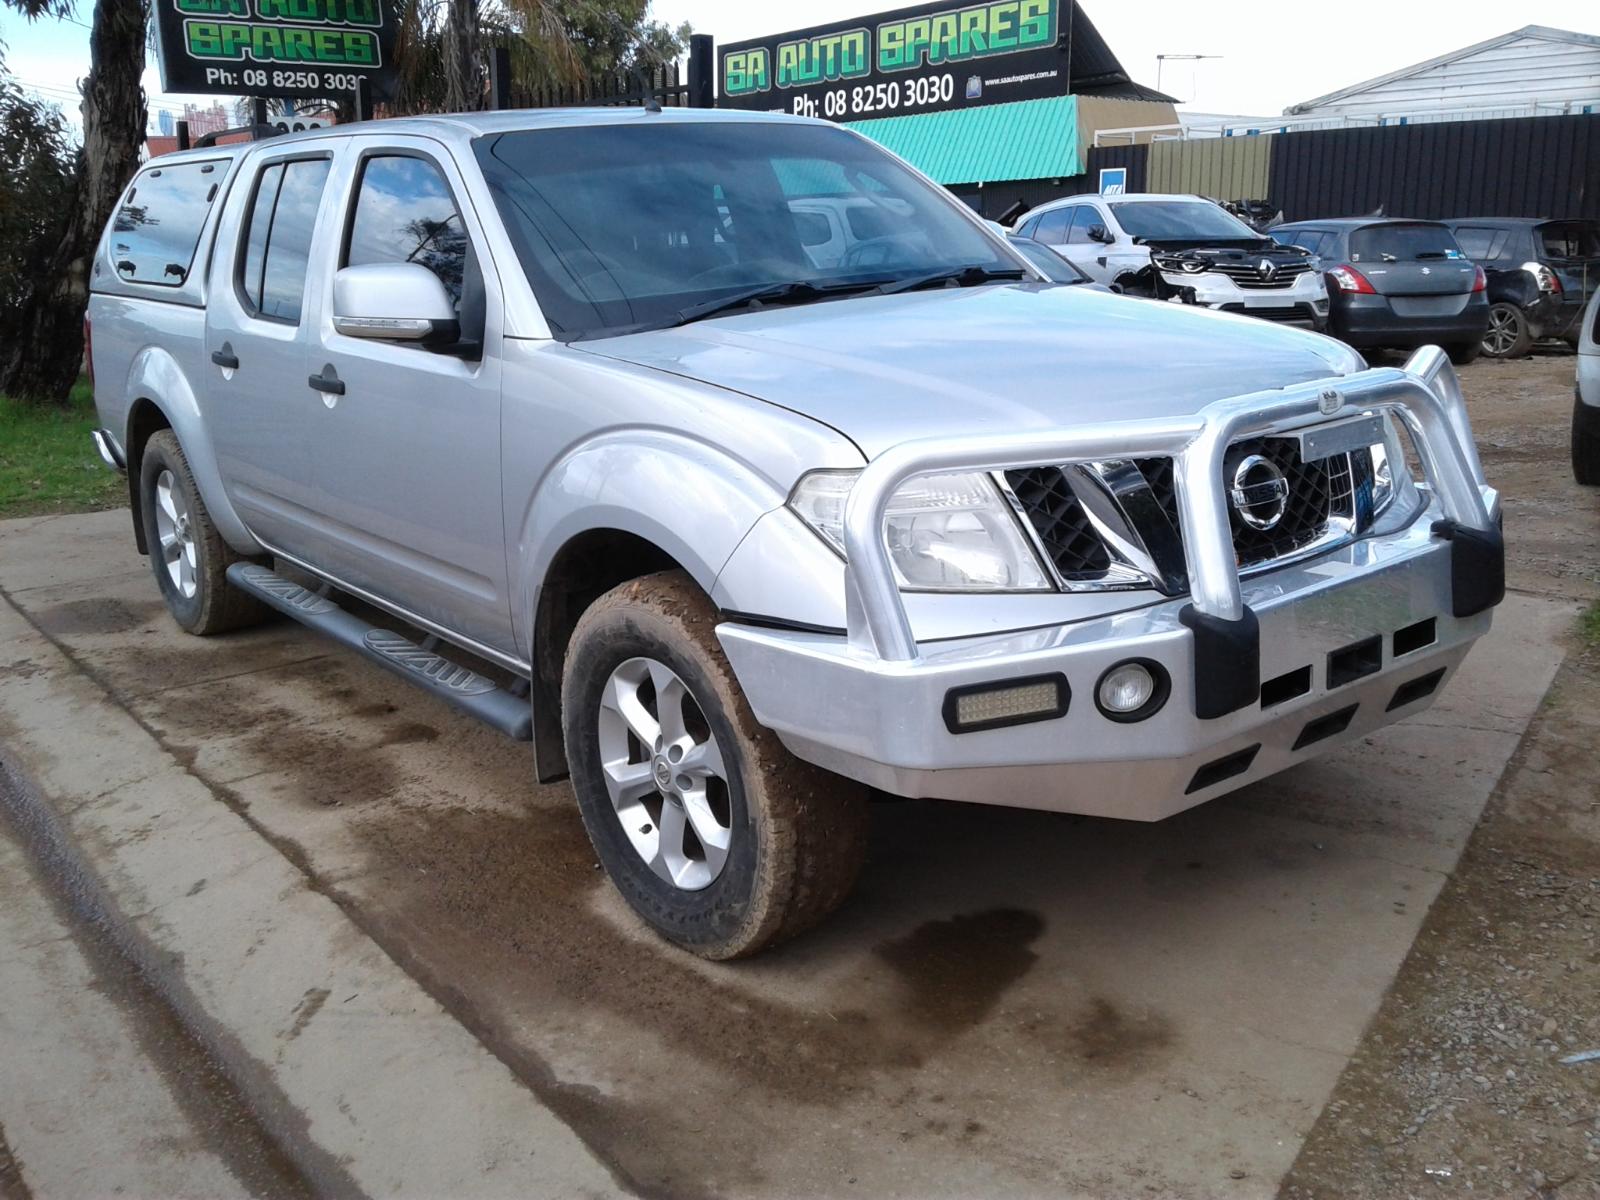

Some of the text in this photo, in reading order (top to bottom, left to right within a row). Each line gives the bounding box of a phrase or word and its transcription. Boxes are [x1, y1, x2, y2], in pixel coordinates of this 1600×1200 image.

[188, 22, 373, 63] SPARES
[726, 0, 1050, 91] SA AUTO SPARES
[205, 68, 367, 91] Ph: 08 8250 303
[793, 73, 954, 118] Ph: 08 8250 3030
[984, 69, 1058, 86] www.saautospares.com.au
